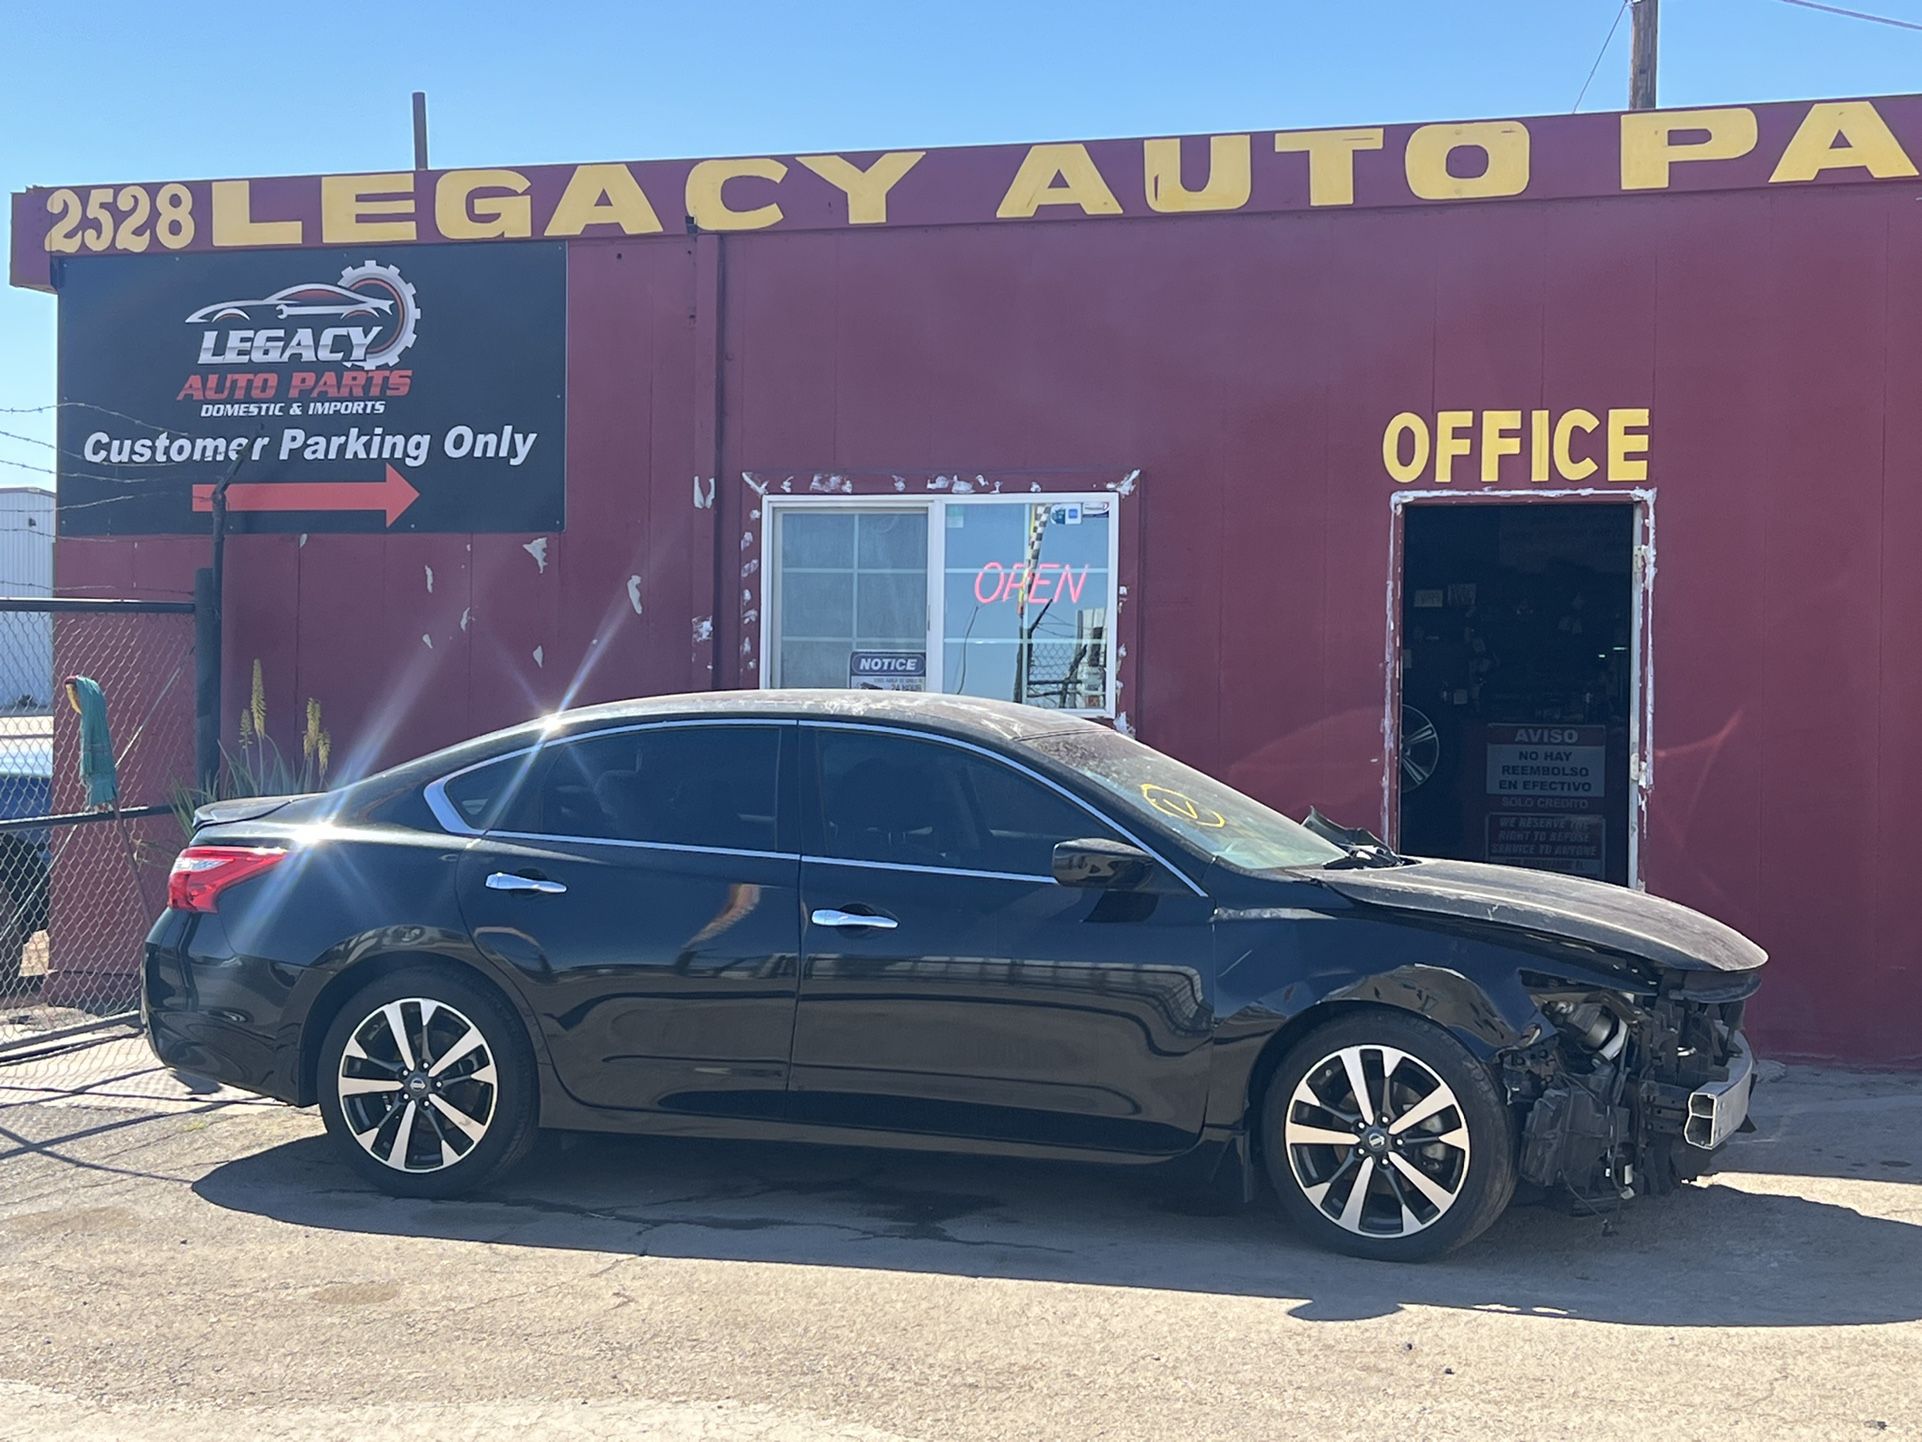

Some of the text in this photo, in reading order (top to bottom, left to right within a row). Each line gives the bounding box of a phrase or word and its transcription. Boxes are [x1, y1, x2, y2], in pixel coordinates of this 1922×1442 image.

[44, 101, 1921, 253] 2528 LEGACY AUTO PA
[198, 326, 383, 364] LEGACY
[176, 369, 413, 400] AUTO PARTS
[201, 401, 386, 417] DOMESTIC & IMPORTS
[84, 425, 538, 467] Customer Parking Only
[1382, 408, 1650, 483] OFFICE
[974, 562, 1089, 604] OPEN
[860, 658, 918, 671] NOTICE
[1515, 728, 1578, 743] AVISO
[1519, 750, 1572, 761] NO HAY
[1502, 765, 1589, 777] REEMBOLSO
[1499, 779, 1592, 792] EN EFECTIVO
[1501, 797, 1533, 808] SOLO
